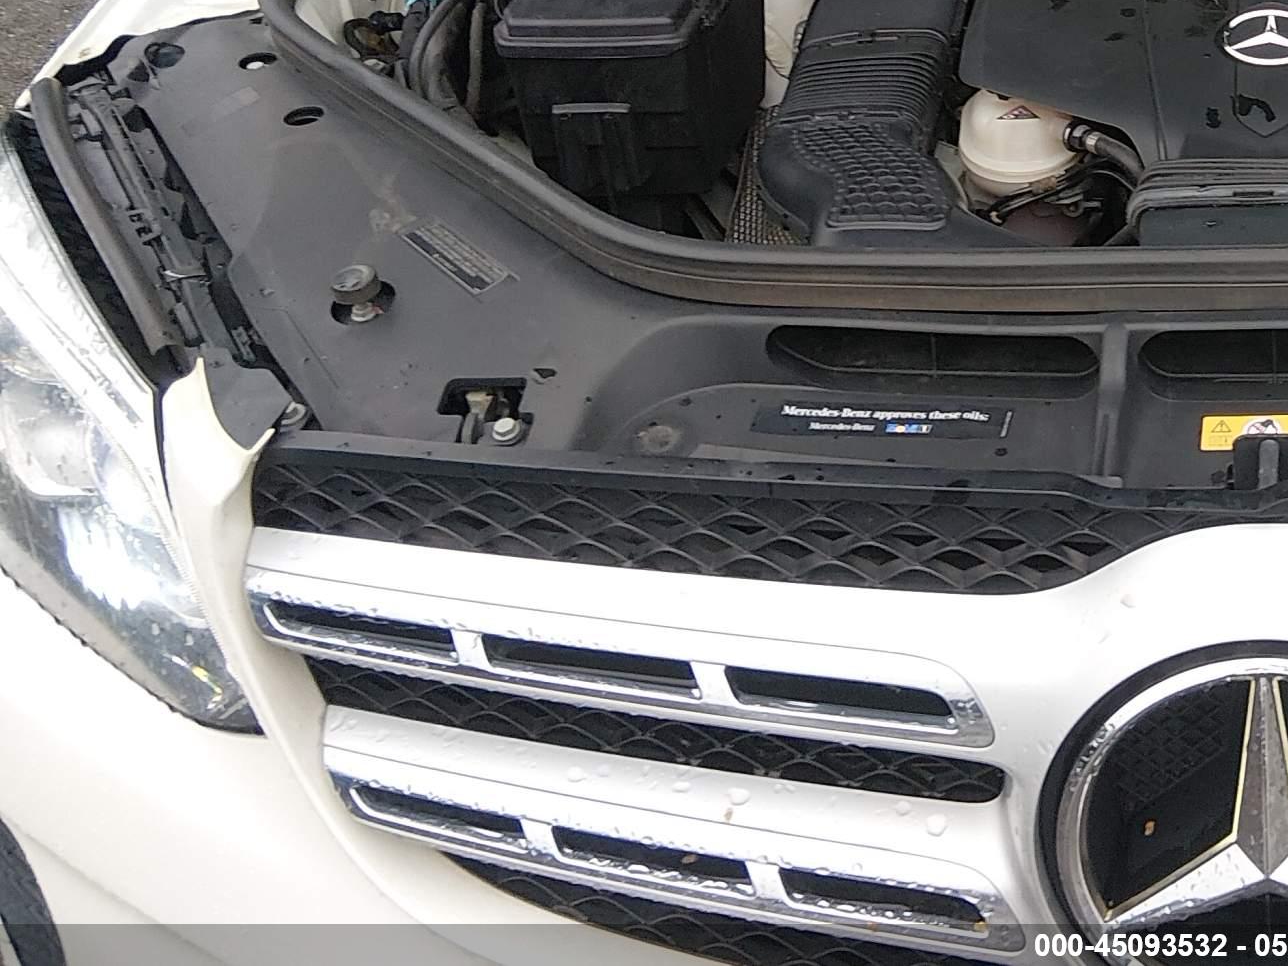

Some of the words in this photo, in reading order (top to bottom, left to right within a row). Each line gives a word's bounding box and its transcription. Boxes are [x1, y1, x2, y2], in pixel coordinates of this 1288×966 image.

[781, 405, 872, 418] Mercedes-Benz
[872, 411, 928, 421] approves
[928, 411, 962, 420] these
